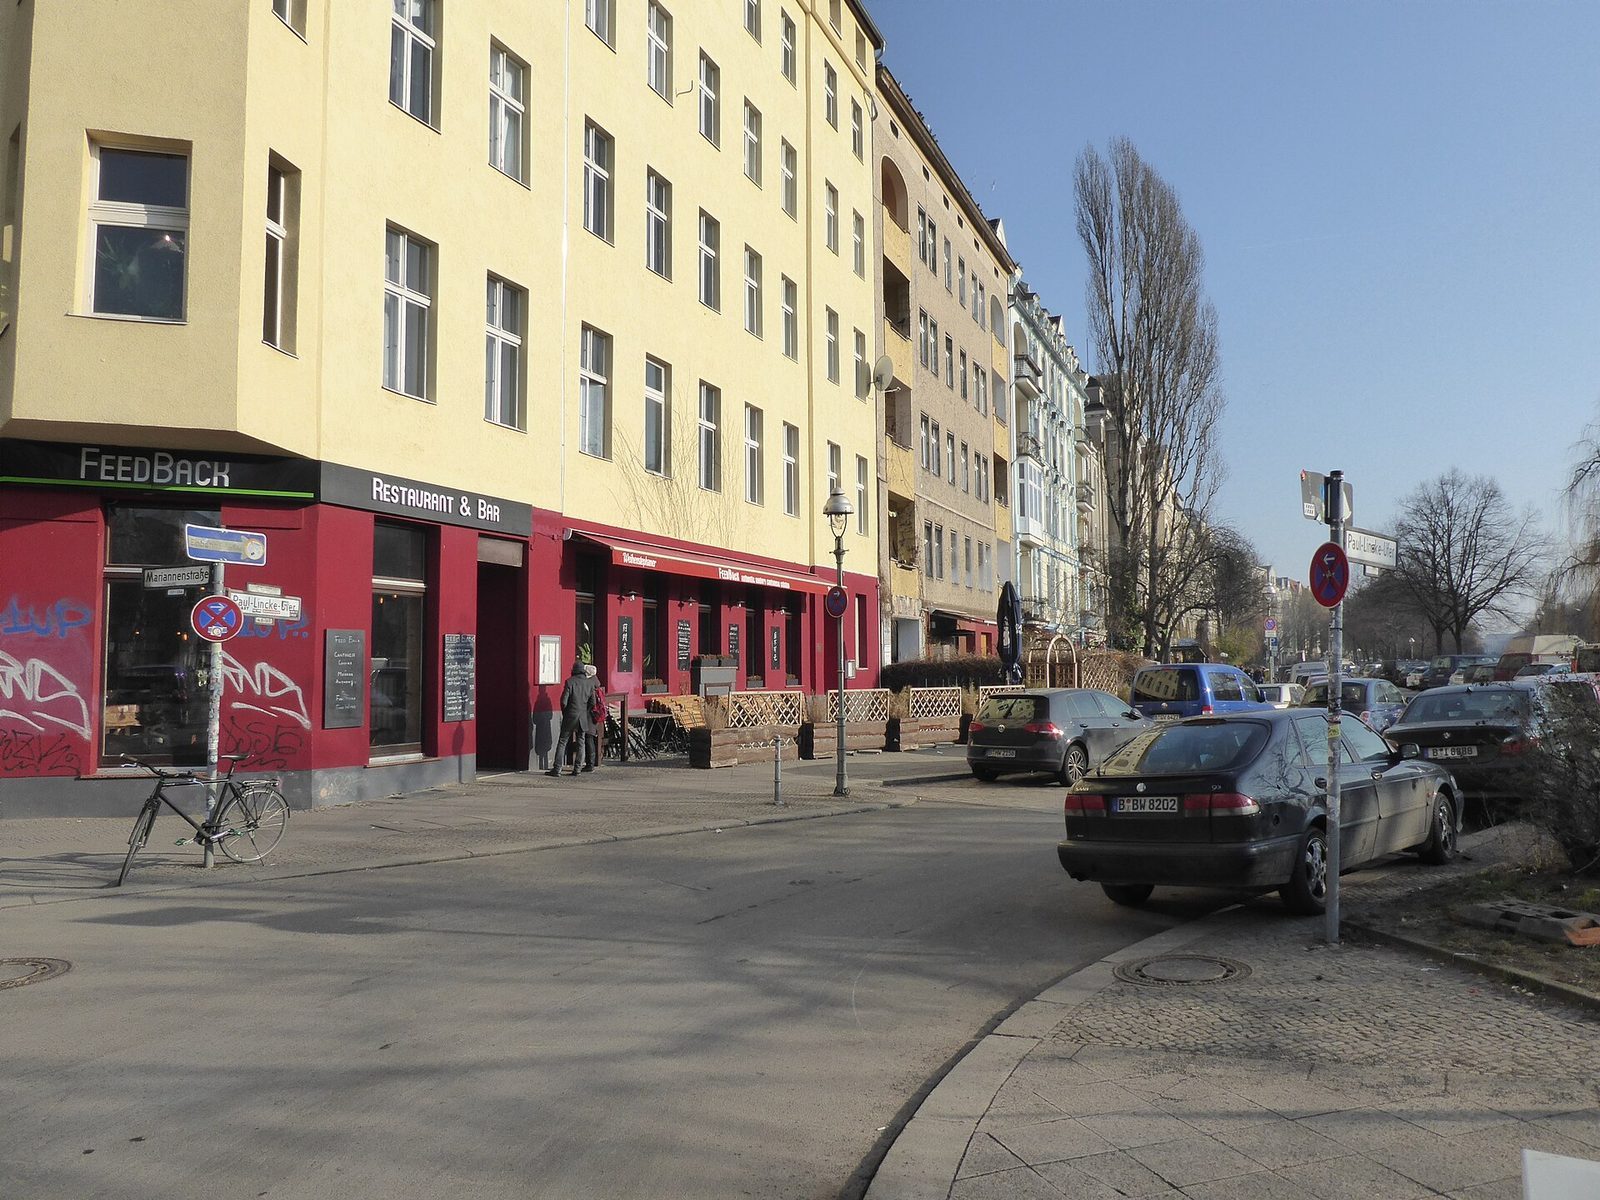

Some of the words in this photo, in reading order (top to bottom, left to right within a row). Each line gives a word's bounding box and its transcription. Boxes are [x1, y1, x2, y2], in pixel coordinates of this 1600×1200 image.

[372, 476, 454, 515] RESTAURANT
[460, 495, 472, 517] &
[477, 499, 500, 523] BAR
[1347, 533, 1395, 559] Paul-Lincke-Ufer
[145, 565, 209, 584] Mariannenstraße
[1118, 799, 1125, 811] B
[1131, 799, 1145, 811] BW
[1148, 799, 1177, 811] 8202
